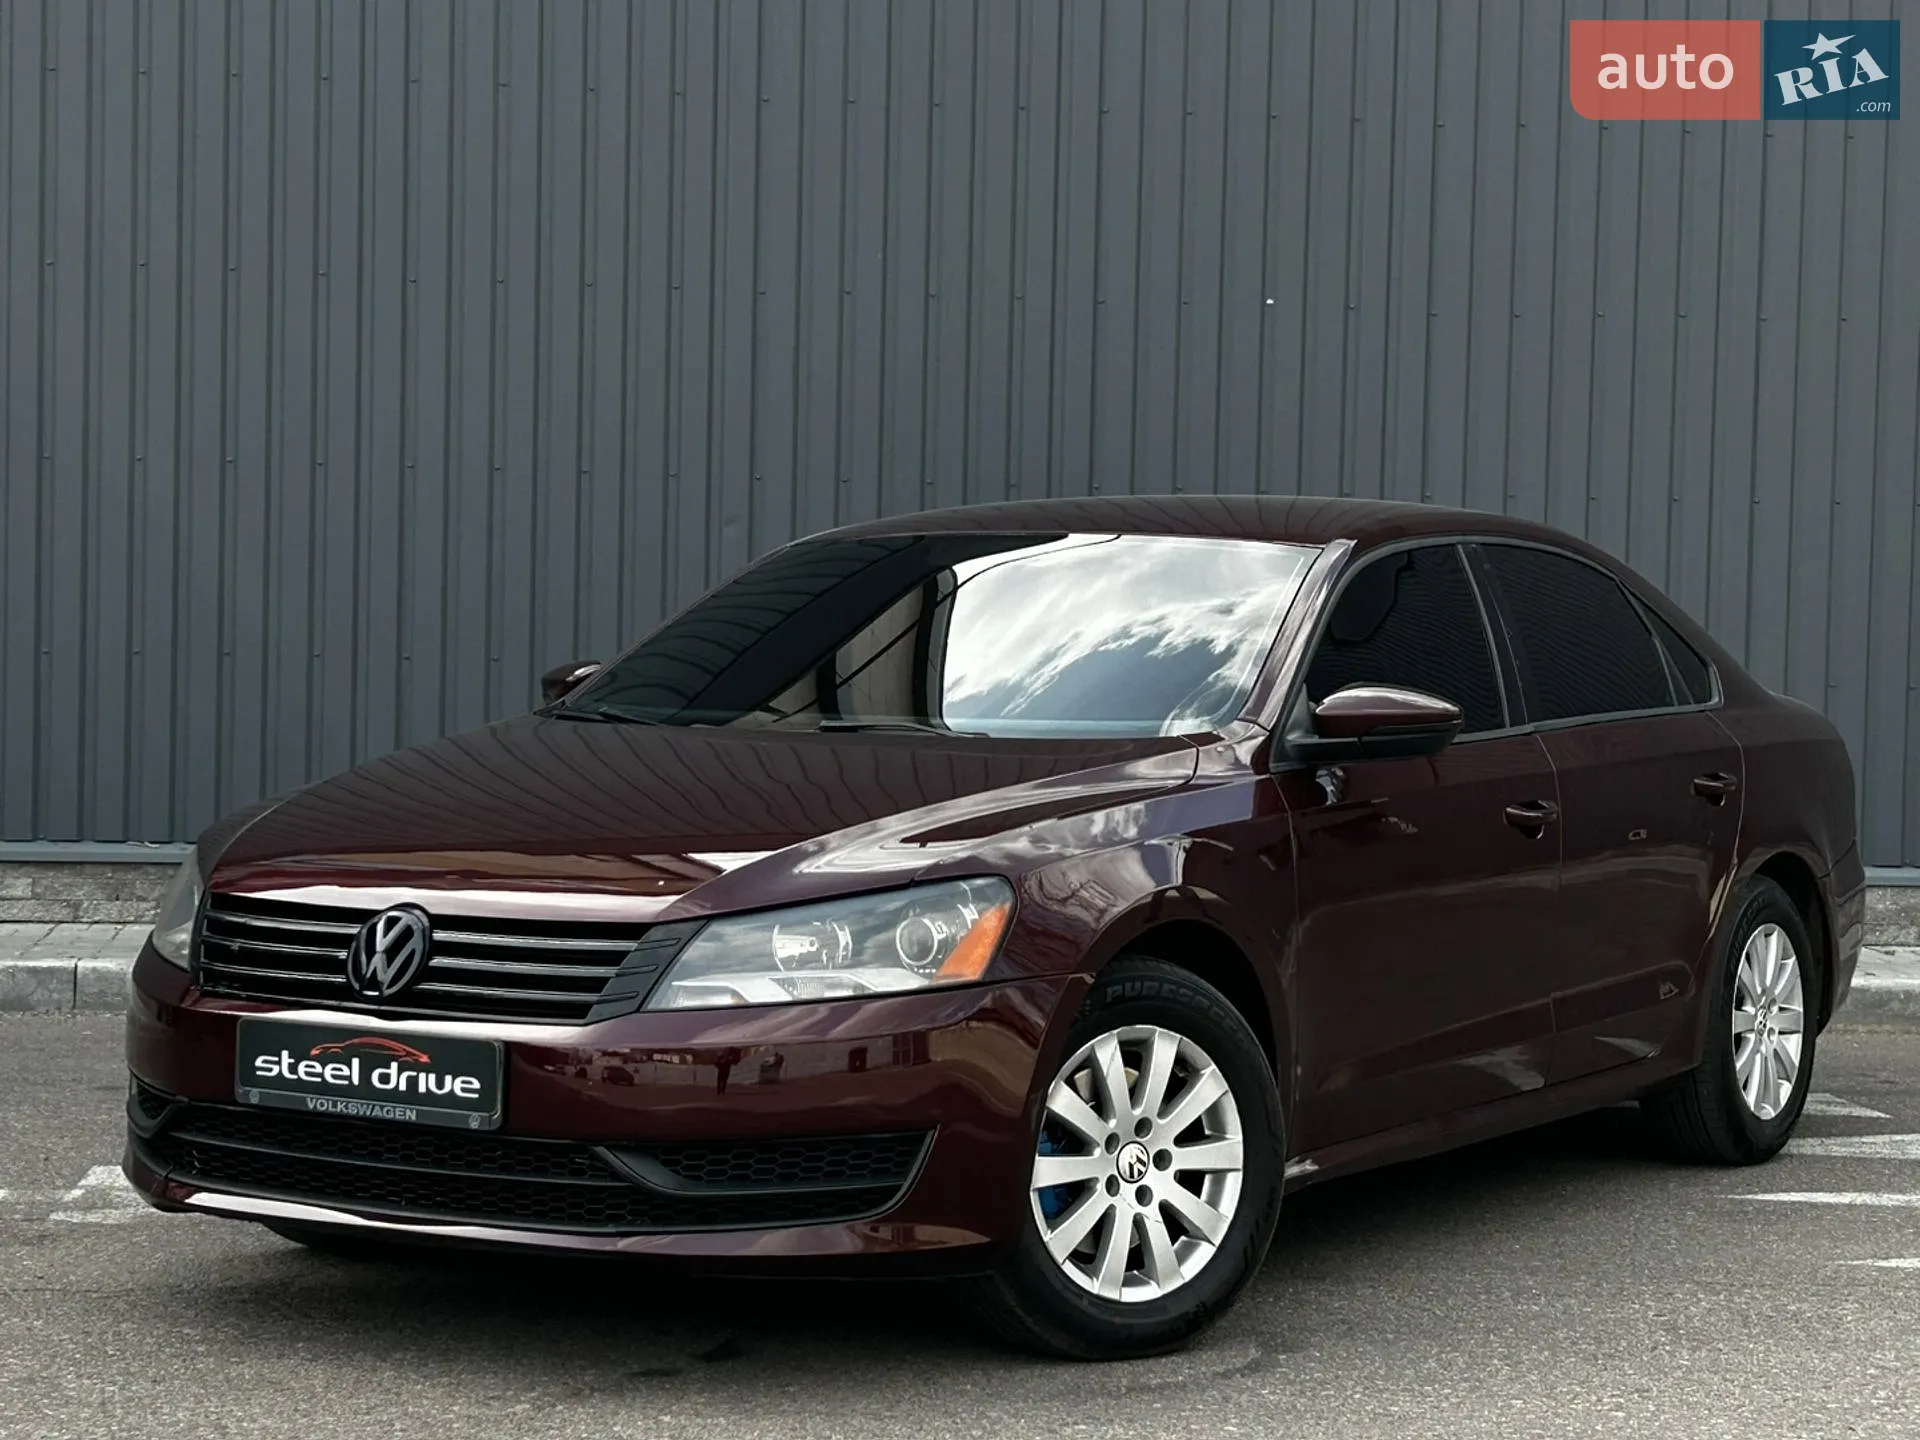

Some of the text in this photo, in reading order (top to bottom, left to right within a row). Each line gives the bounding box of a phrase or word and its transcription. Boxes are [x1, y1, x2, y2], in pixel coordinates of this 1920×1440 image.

[254, 1050, 481, 1099] steel drive
[306, 1097, 416, 1121] VOLKSWAGEN
